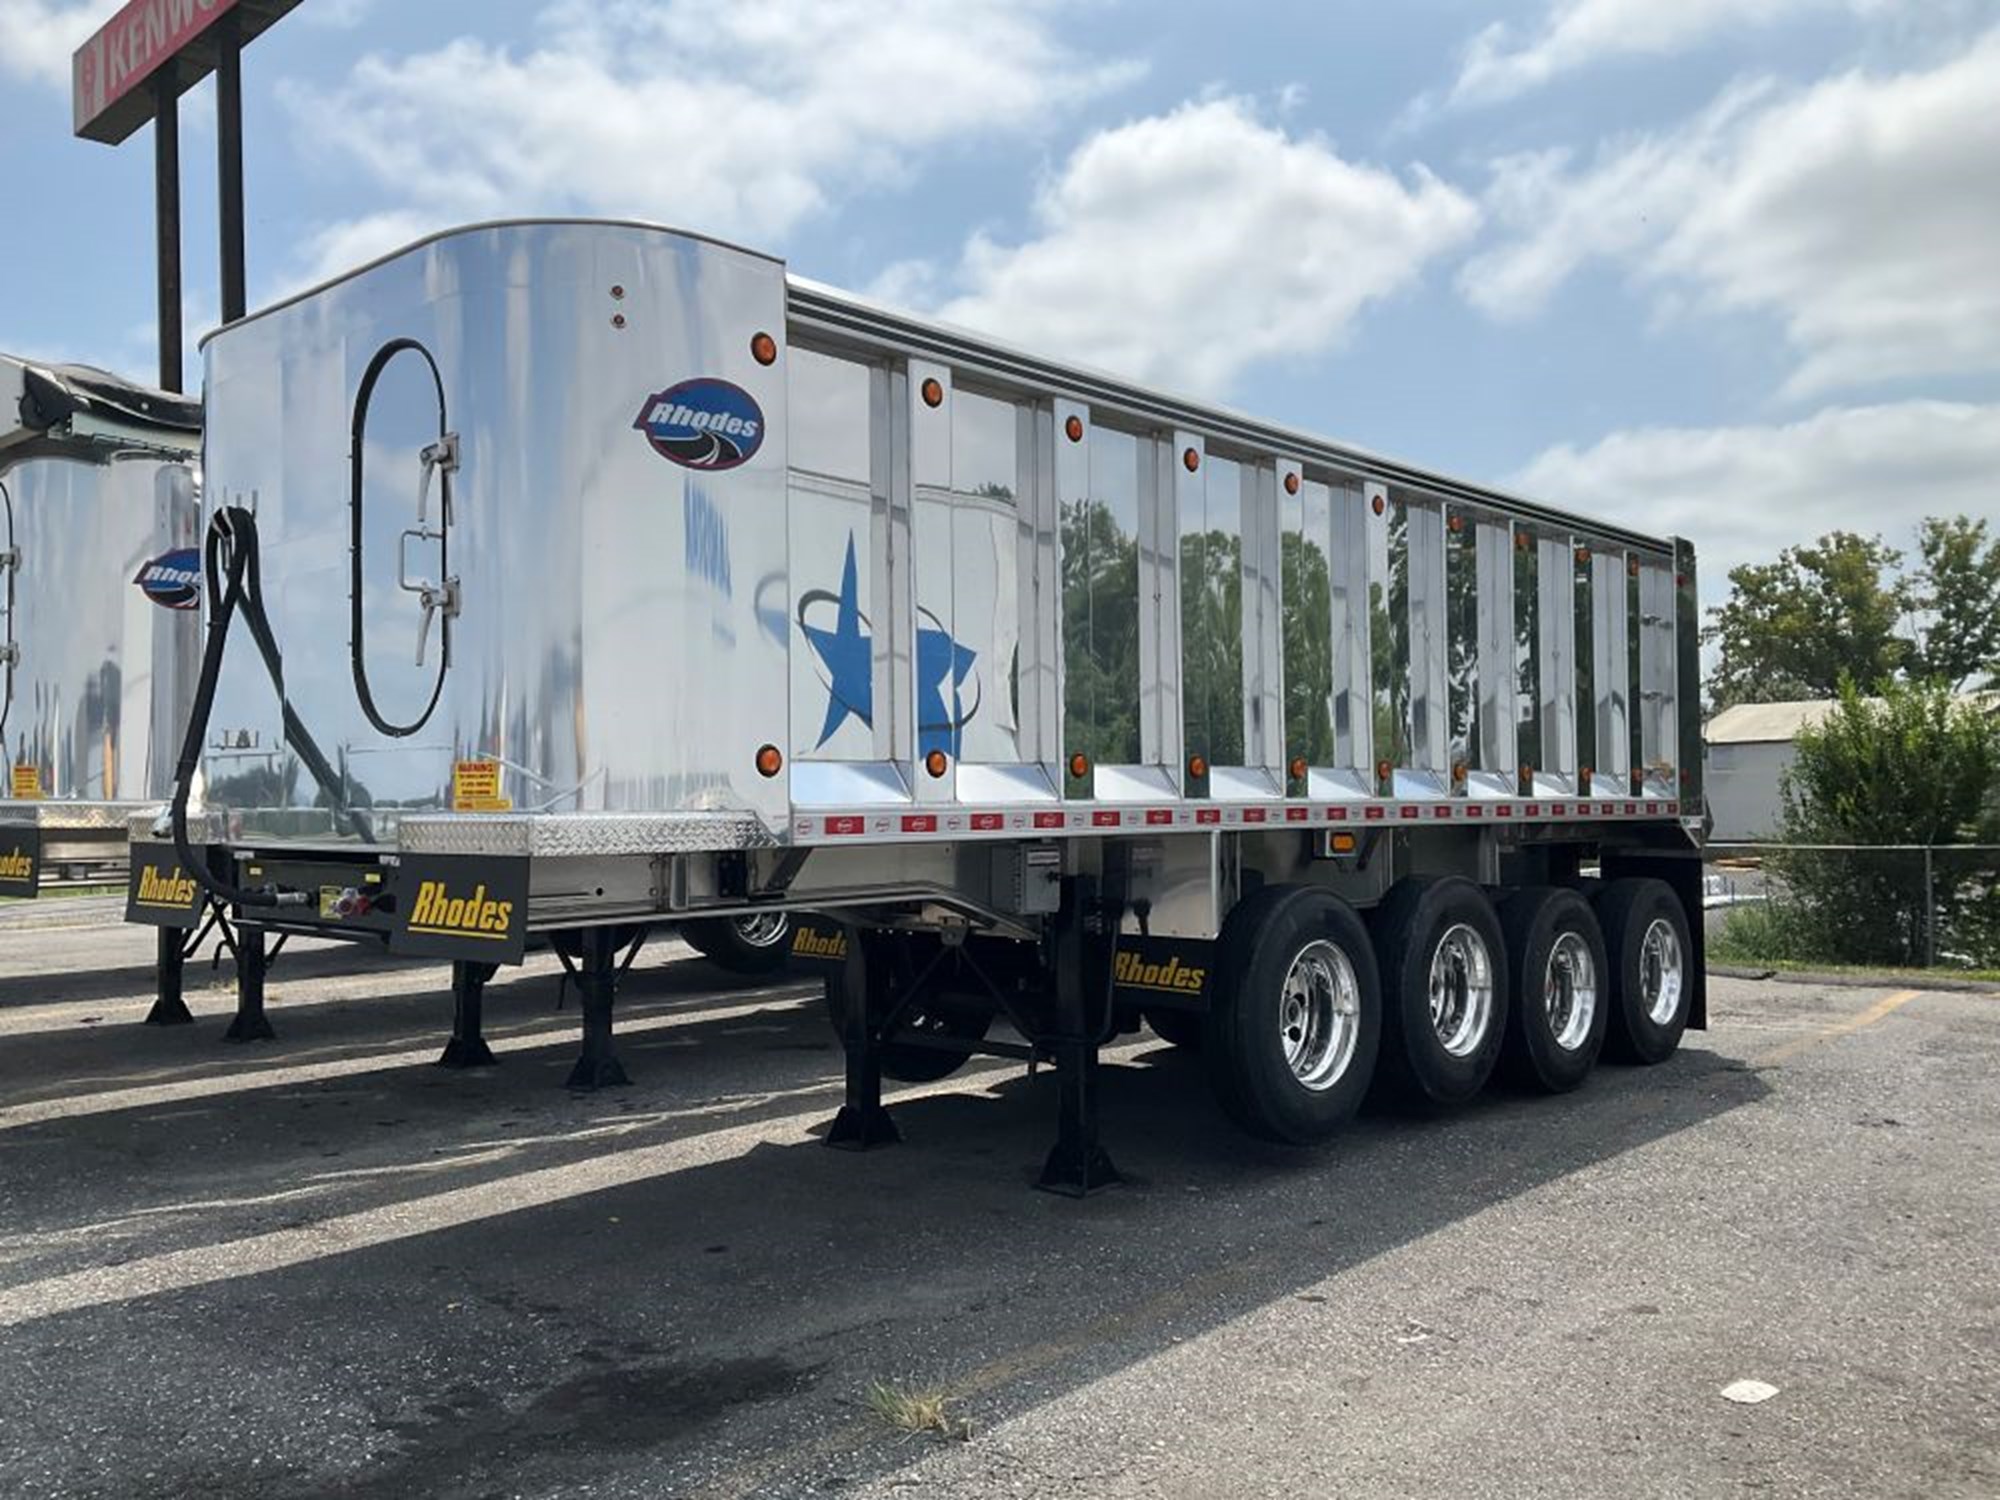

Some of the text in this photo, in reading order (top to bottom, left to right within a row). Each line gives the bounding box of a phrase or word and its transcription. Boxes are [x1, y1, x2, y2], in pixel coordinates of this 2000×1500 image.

[109, 0, 217, 89] KENW
[648, 402, 759, 437] Rhodes
[137, 864, 197, 902] Rhodes
[410, 881, 513, 930] Rhodes
[1115, 952, 1205, 988] Rhodes
